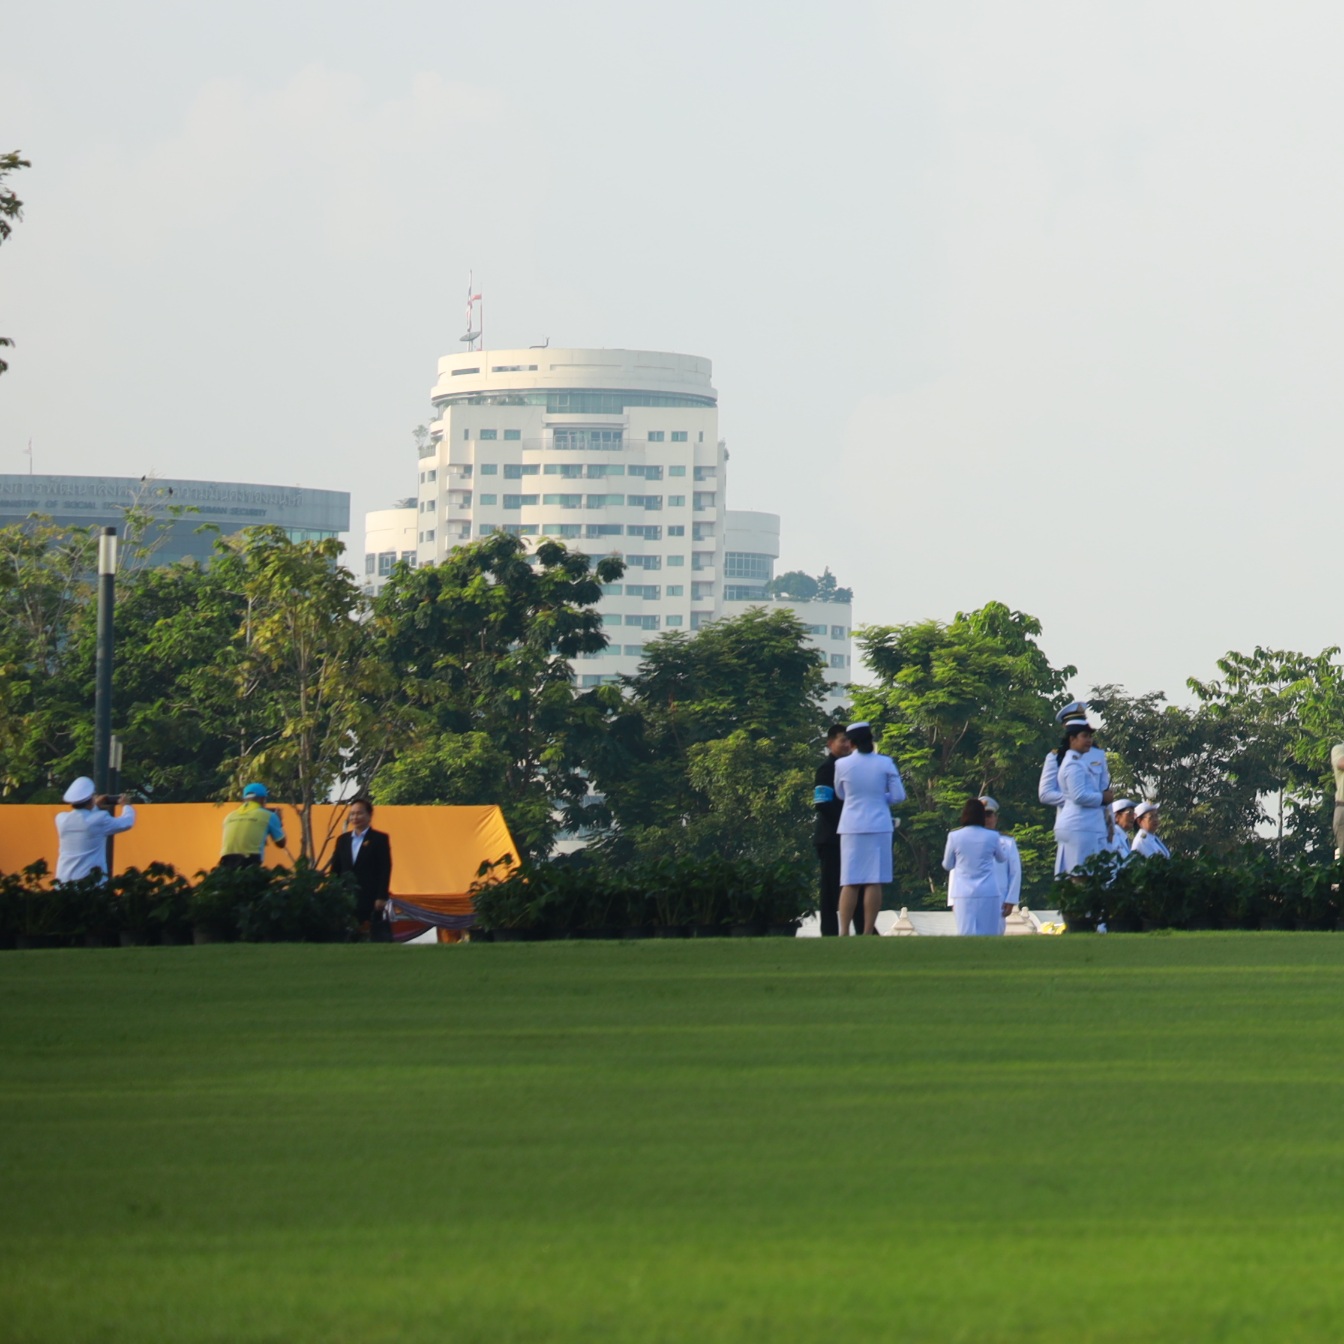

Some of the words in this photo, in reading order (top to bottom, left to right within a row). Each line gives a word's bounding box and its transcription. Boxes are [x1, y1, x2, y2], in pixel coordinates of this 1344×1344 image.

[45, 499, 58, 508] OF
[64, 500, 96, 509] SOCIAL
[197, 506, 227, 514] UMAN
[230, 508, 267, 516] SECURITY
